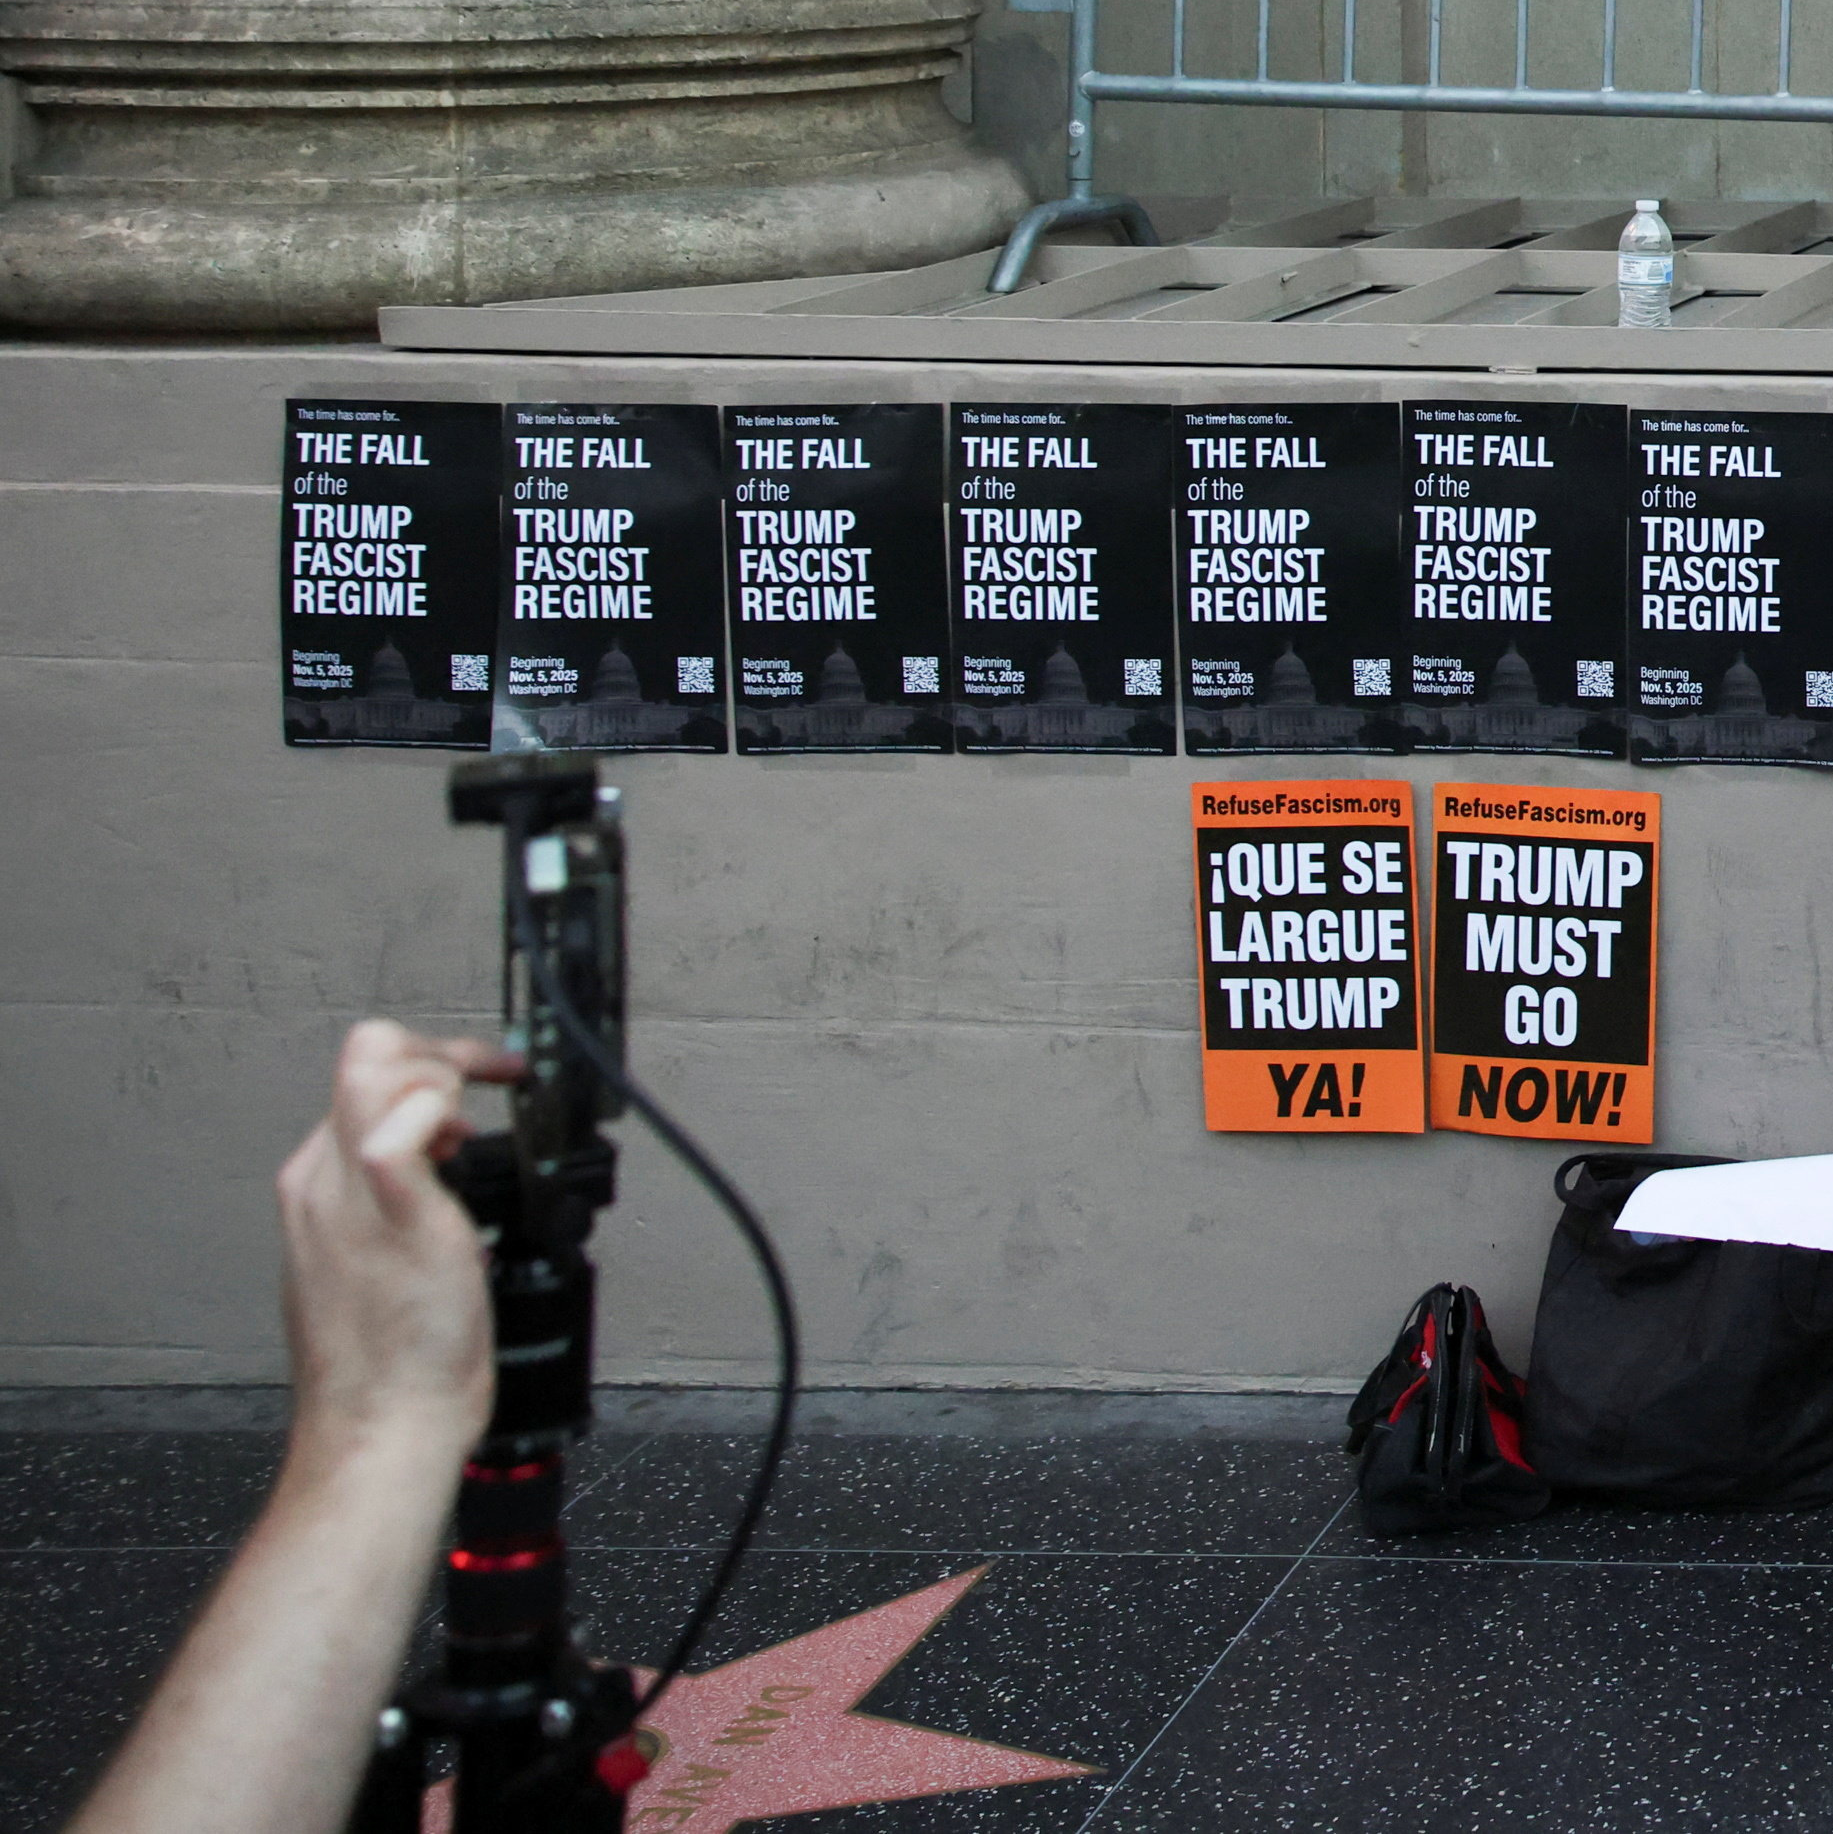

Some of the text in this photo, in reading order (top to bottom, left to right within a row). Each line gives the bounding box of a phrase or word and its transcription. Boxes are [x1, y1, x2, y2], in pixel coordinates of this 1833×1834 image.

[293, 503, 411, 539] TRUMP
[513, 509, 633, 543] TRUMP
[961, 509, 1081, 543] TRUMP
[1188, 509, 1309, 544] TRUMP
[1641, 517, 1764, 553] TRUMP
[294, 542, 426, 578] FASCIST
[516, 547, 649, 581] FASCIST
[964, 547, 1097, 582] FASCIST
[1191, 548, 1324, 583] FASCIST
[1643, 556, 1779, 592] FASCIST
[294, 580, 426, 616] REGIME
[515, 585, 652, 619] REGIME
[965, 585, 1099, 620] REGIME
[1191, 587, 1327, 622] REGIME
[1643, 595, 1780, 632] REGIME
[1201, 793, 1401, 818] RefuseFascism.org
[1444, 797, 1647, 831] RefuseFascism.org
[1211, 841, 1403, 903] ¡QUE SE
[1447, 842, 1642, 908] TRUMP
[1210, 910, 1406, 962] LARGUE
[1466, 913, 1621, 977] MUST
[1221, 978, 1399, 1029] TRUMP
[1505, 985, 1577, 1046] GO
[1267, 1062, 1366, 1118] YA!
[1458, 1063, 1628, 1126] NOW!
[640, 1765, 730, 1825] AVE
